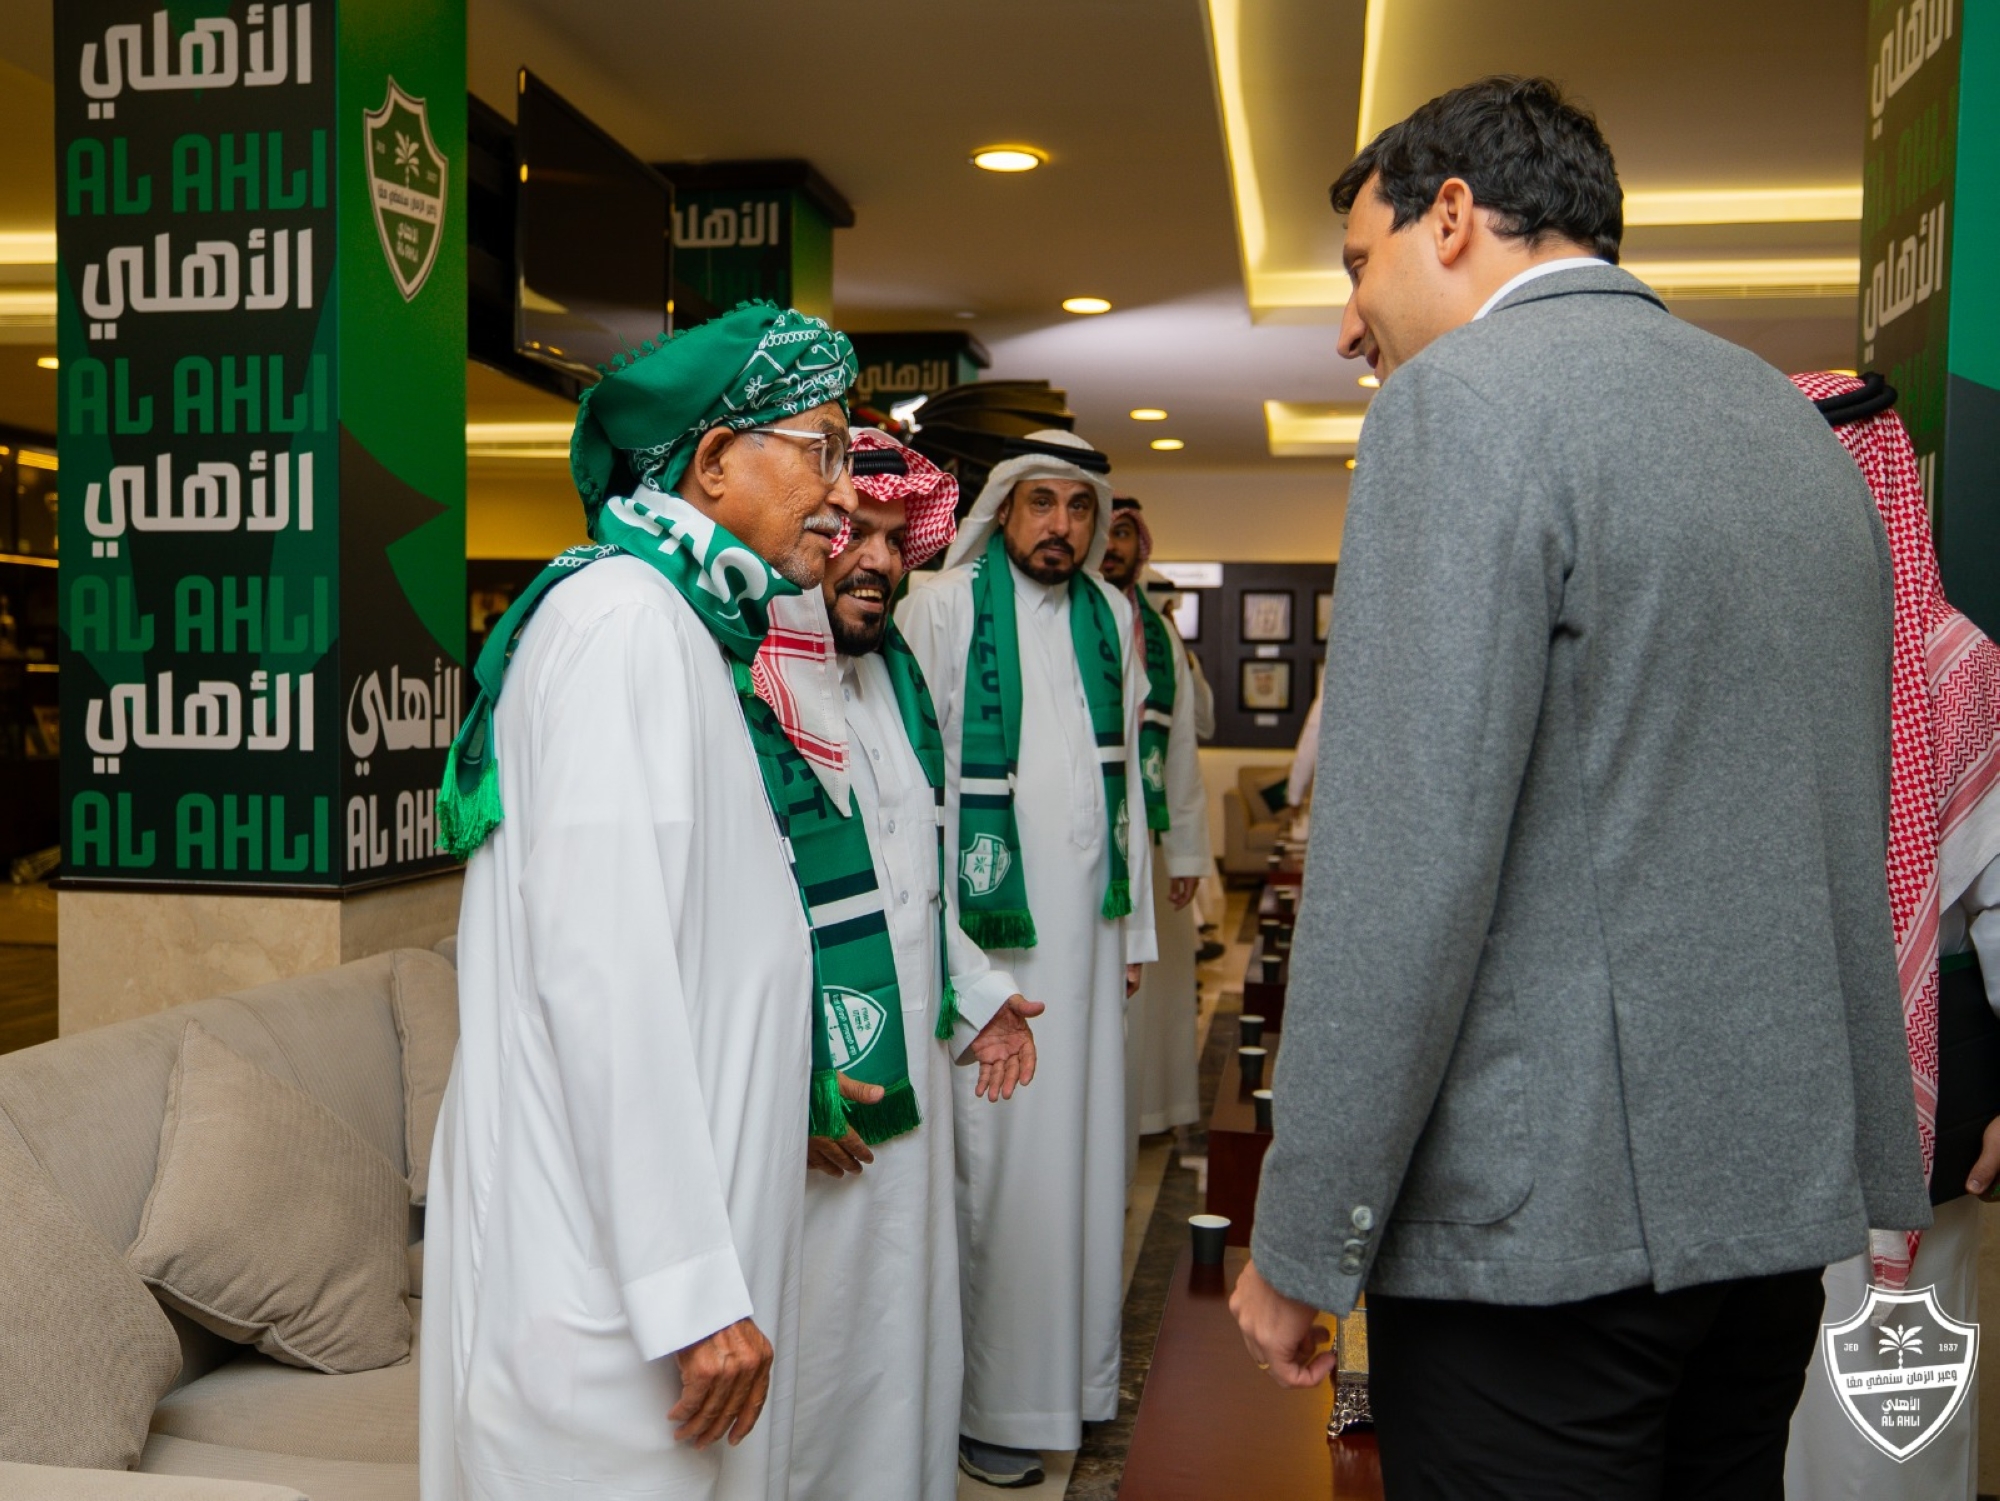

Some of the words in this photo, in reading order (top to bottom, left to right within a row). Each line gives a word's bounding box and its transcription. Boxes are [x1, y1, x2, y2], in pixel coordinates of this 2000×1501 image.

[80, 3, 312, 119] الأهلي
[67, 137, 152, 216] AL
[172, 129, 327, 214] AHLI
[673, 201, 779, 249] الأهل
[82, 228, 313, 340] الأهلي
[1863, 201, 1945, 364] الأهلي
[68, 356, 153, 435] AL
[173, 353, 328, 434] AHLI
[84, 449, 314, 558] الأهلي
[70, 574, 155, 652] AL
[174, 575, 328, 653] AHLI
[85, 670, 314, 774] الأهلي
[347, 656, 460, 777] الأهلي
[70, 791, 156, 868] AL
[175, 793, 330, 874] AHLI
[347, 795, 388, 872] AL
[396, 788, 449, 863] AH
